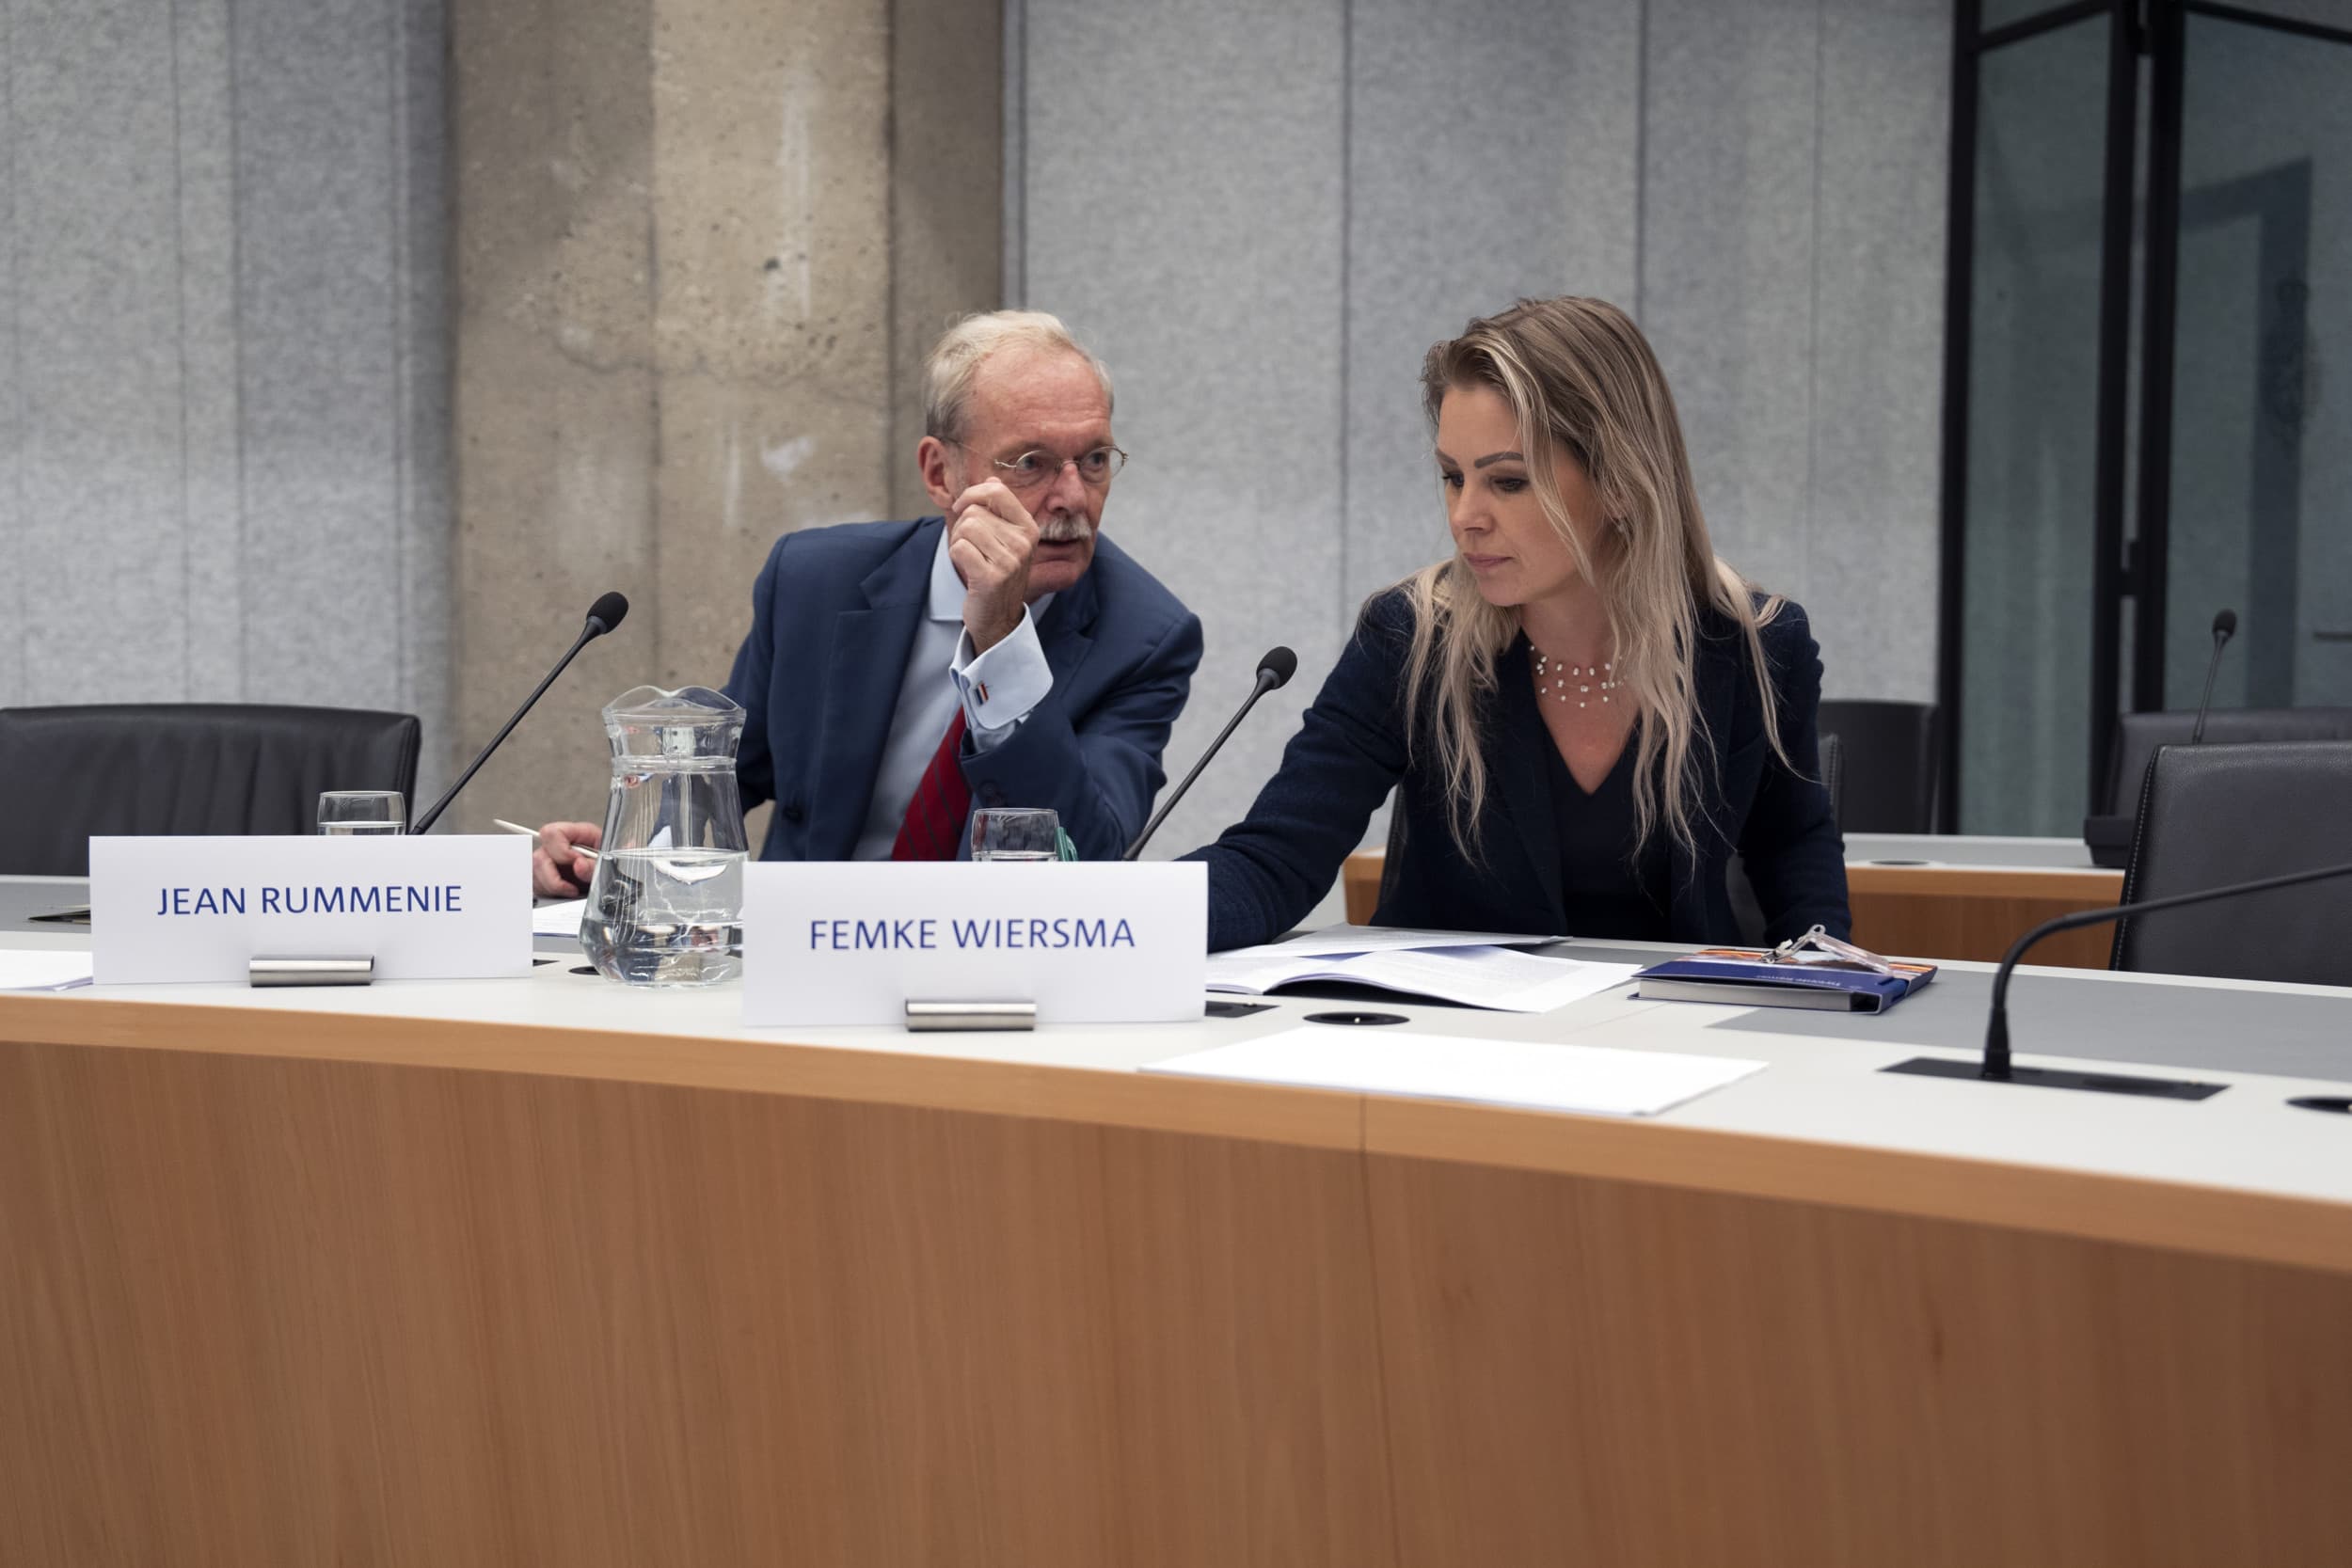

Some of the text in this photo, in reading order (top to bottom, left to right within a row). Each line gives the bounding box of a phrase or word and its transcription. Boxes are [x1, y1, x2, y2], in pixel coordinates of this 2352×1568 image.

[157, 885, 462, 915] JEAN RUMMENIE
[811, 918, 1136, 950] FEMKE WIERSMA
